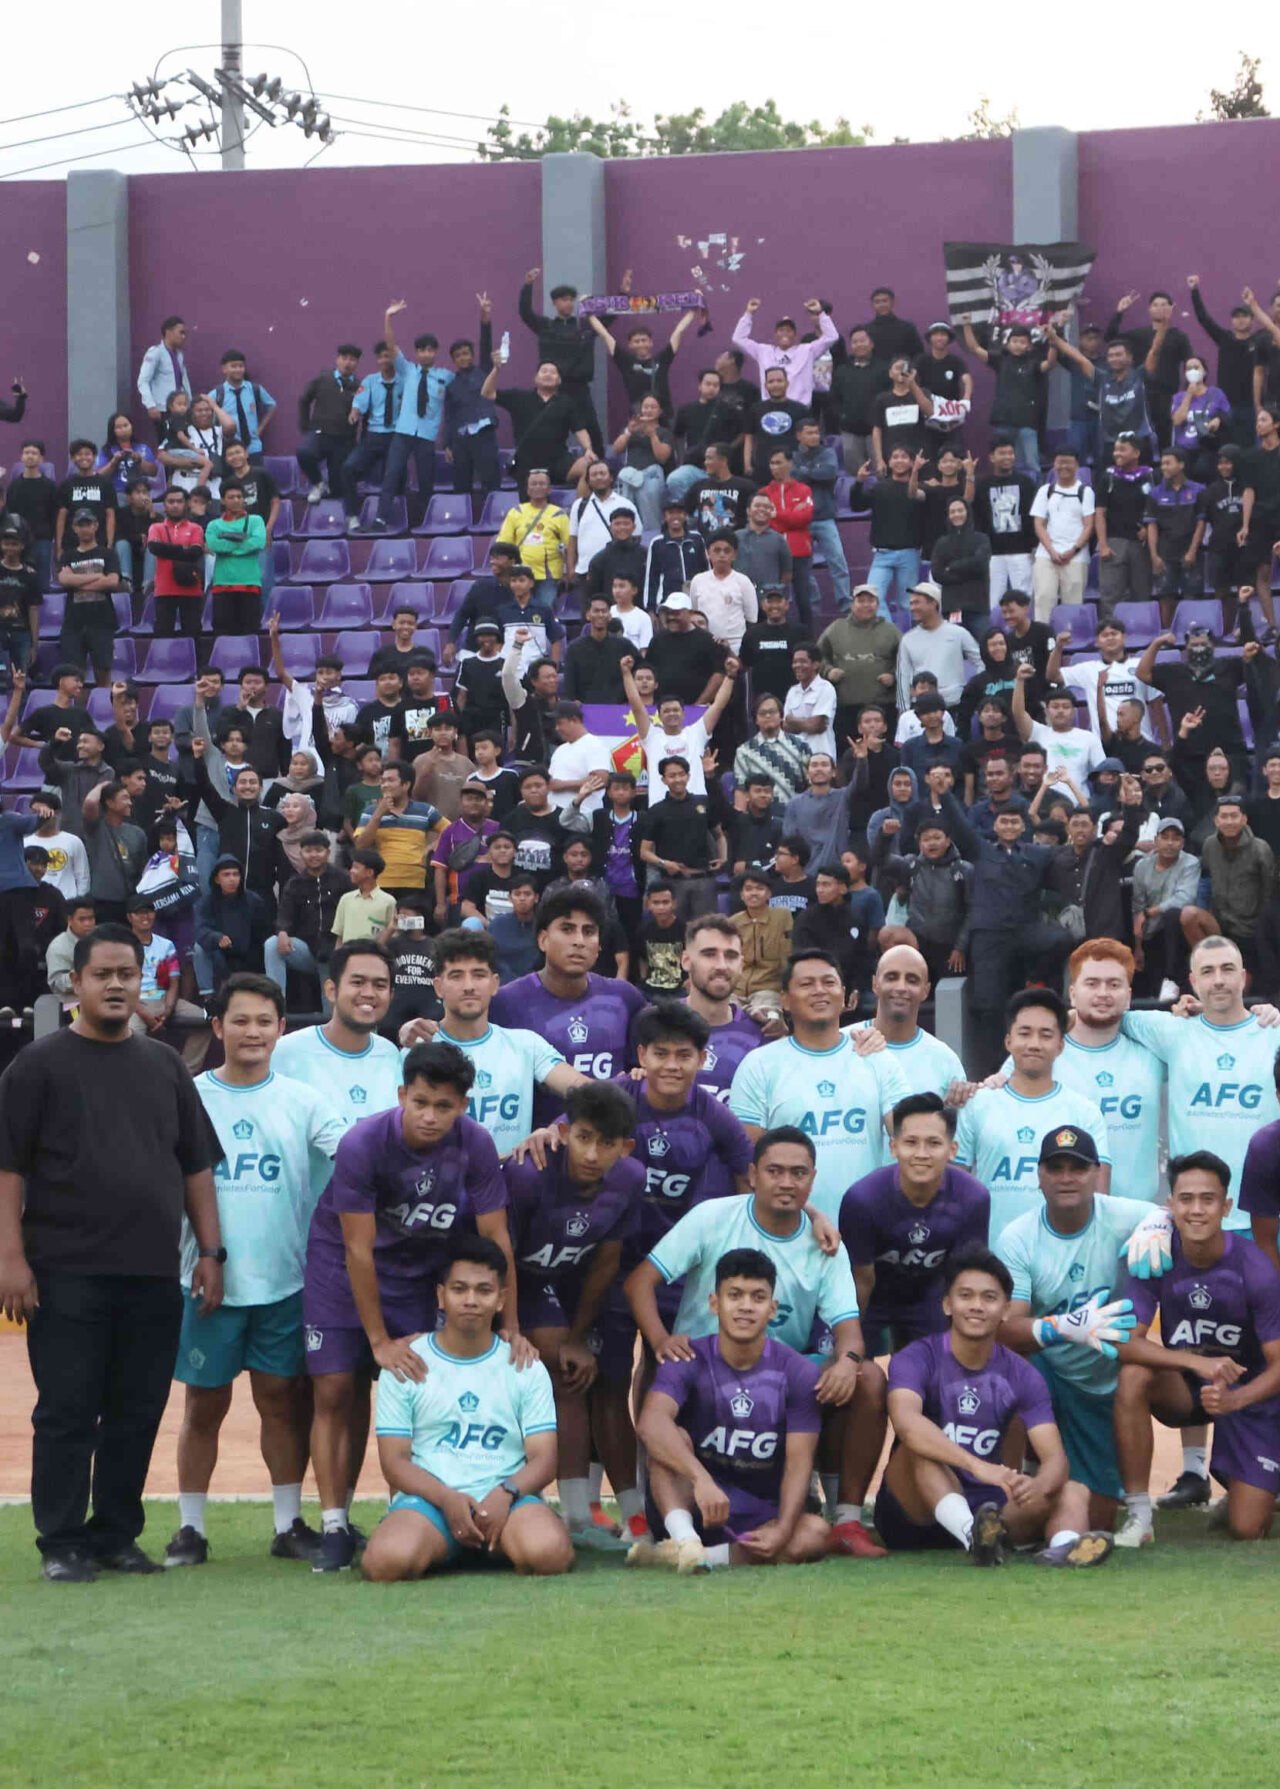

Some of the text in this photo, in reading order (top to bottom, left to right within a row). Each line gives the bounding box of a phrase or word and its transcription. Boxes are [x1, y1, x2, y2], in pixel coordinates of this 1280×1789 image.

[1104, 684, 1134, 695] oasis
[573, 1052, 613, 1080] FG
[1100, 1094, 1141, 1120] FG
[1190, 1082, 1263, 1109] AFG
[800, 1107, 866, 1136] AFG
[213, 1153, 281, 1181] AFG
[991, 1156, 1038, 1182] AF
[645, 1167, 691, 1198] FG
[393, 1203, 457, 1230] AFG
[876, 1248, 948, 1268] AFG
[1169, 1318, 1242, 1346] AFG
[435, 1424, 508, 1450] AFG
[700, 1426, 778, 1458] AFG
[942, 1422, 1000, 1456] AFG
